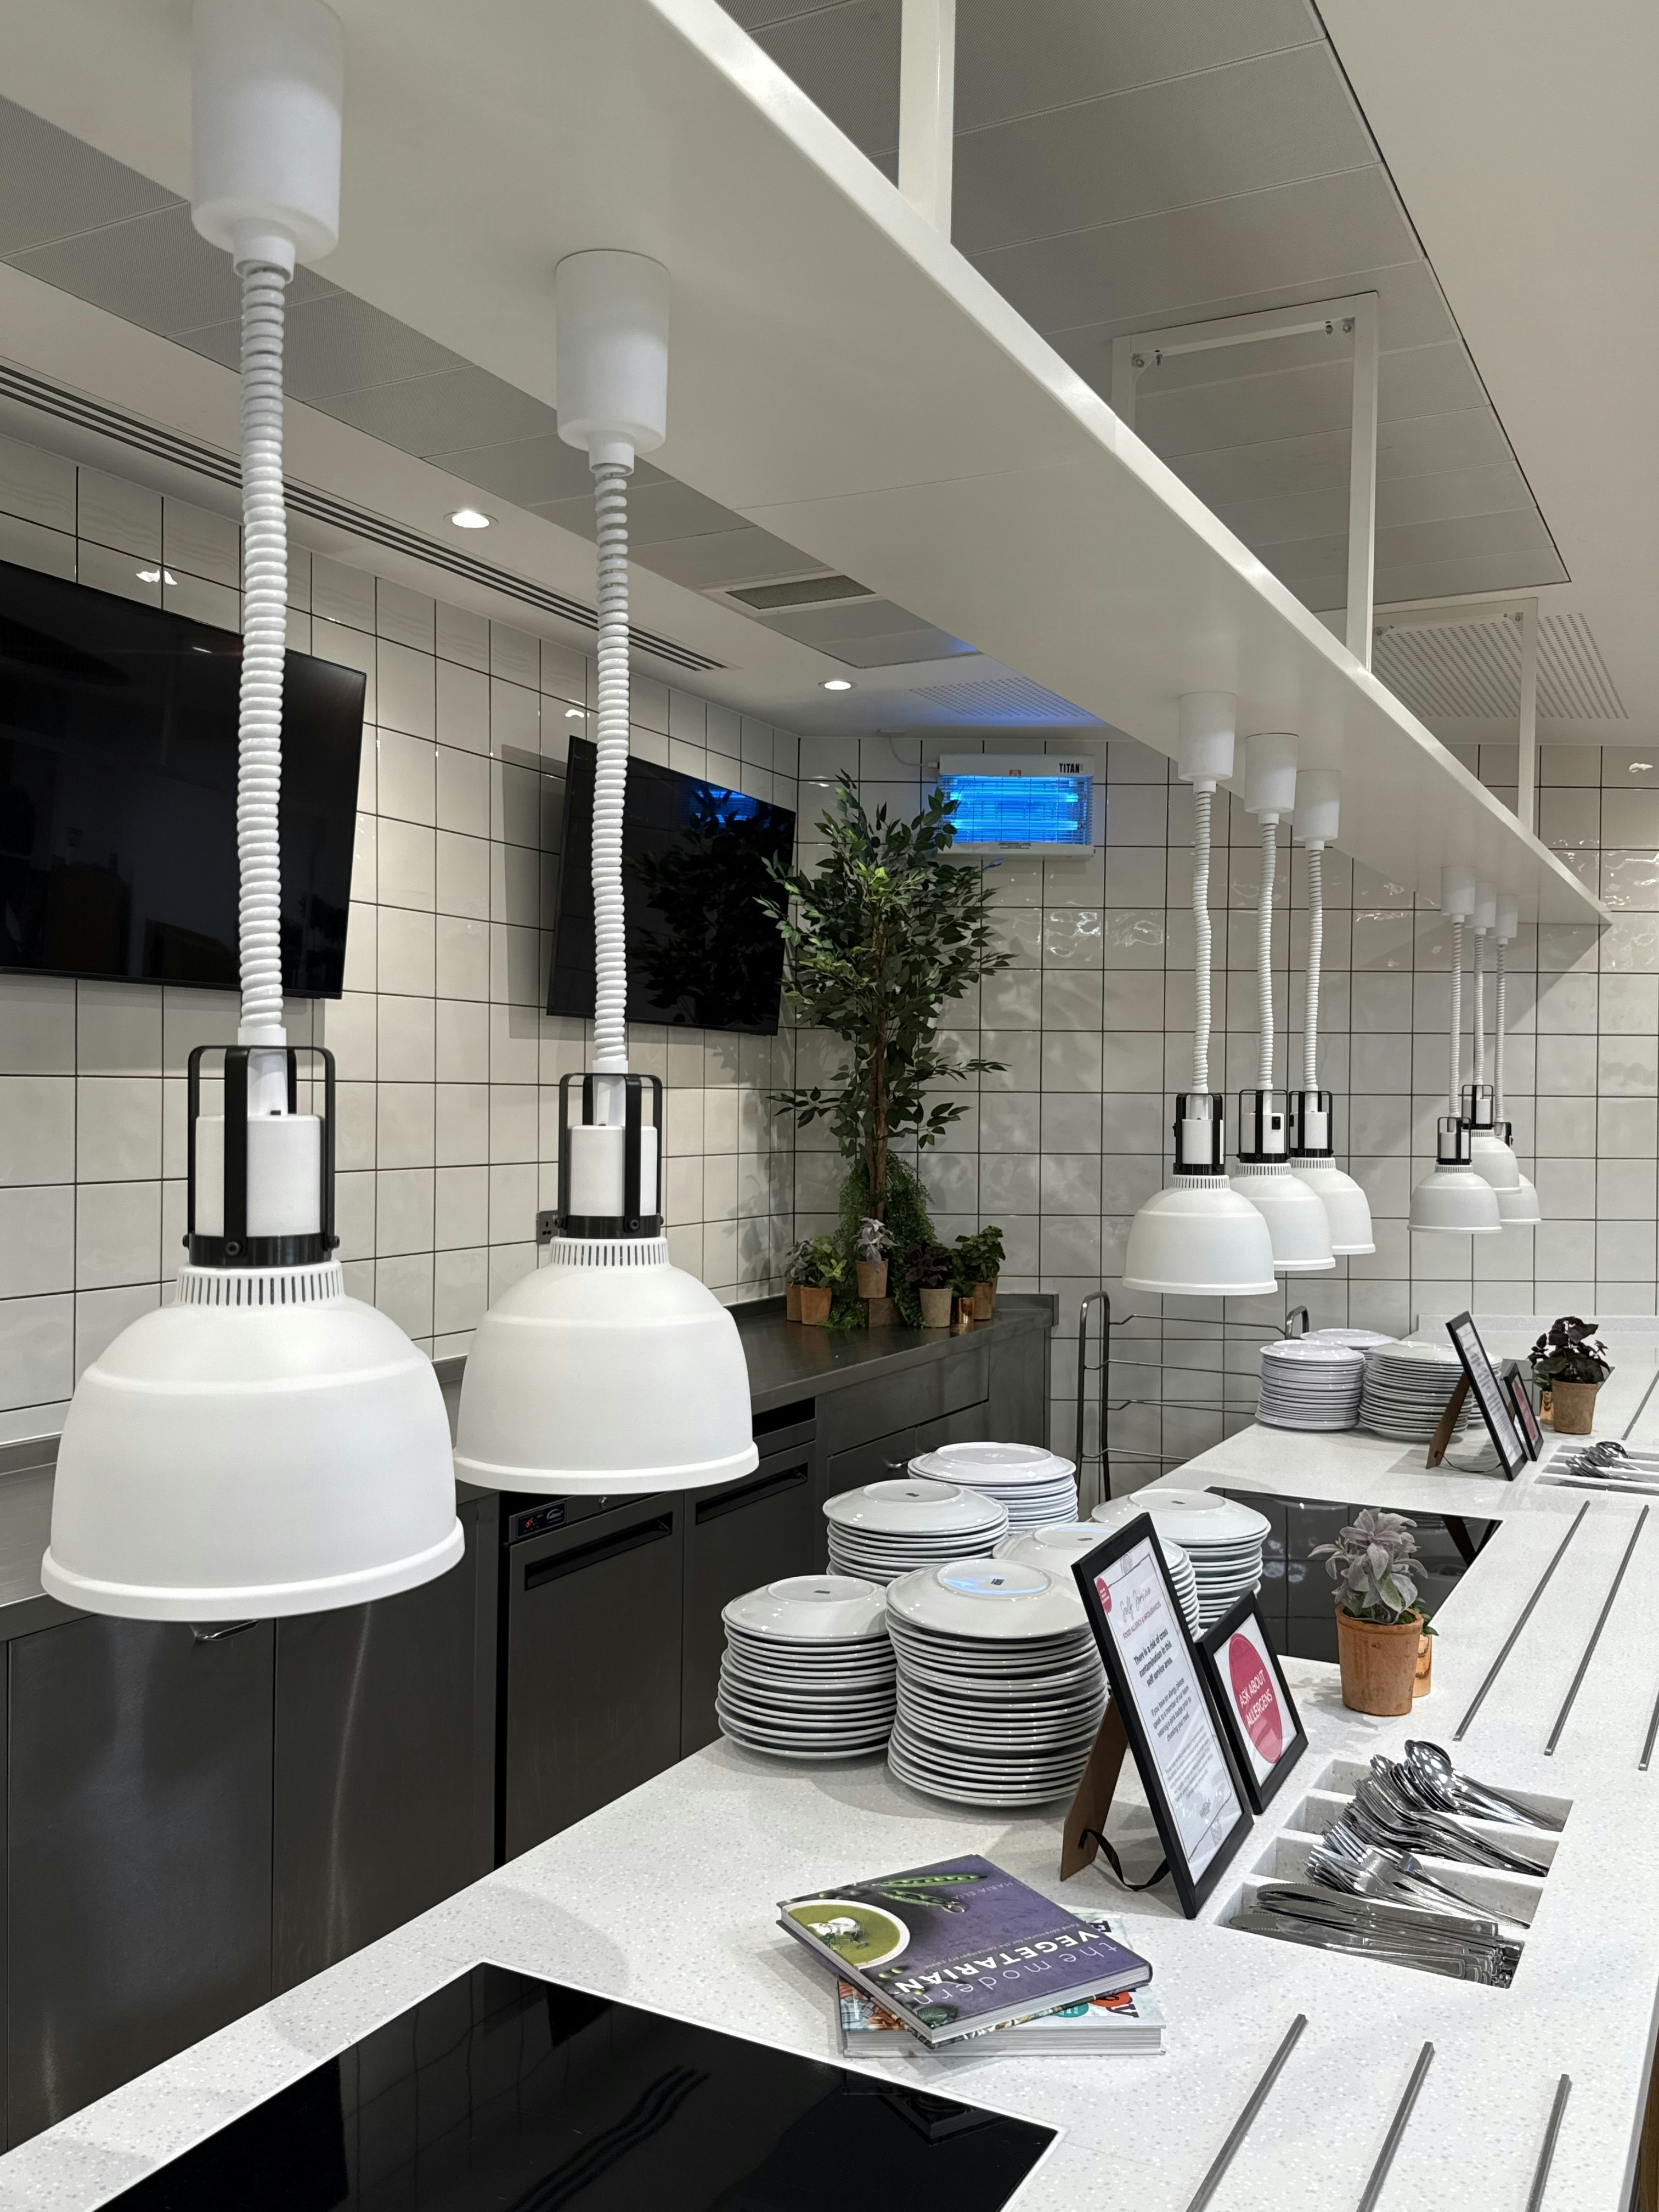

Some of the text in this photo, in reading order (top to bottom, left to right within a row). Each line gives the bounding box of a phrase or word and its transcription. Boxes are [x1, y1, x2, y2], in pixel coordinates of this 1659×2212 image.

[1059, 763, 1080, 774] TITAN
[1133, 1652, 1144, 1665] There
[1142, 1647, 1148, 1656] is
[1155, 1634, 1160, 1644] of
[1159, 1628, 1169, 1640] cross
[1139, 1651, 1163, 1677] contamination
[1160, 1646, 1166, 1655] in
[1153, 1664, 1165, 1680] service
[1239, 1669, 1266, 1708] ASK ABOUT
[1246, 1688, 1273, 1728] ALLERGENS
[952, 1882, 1013, 1899] MARIA ELIA
[896, 1931, 1100, 1993] VEGETARIAN
[913, 1942, 1118, 2005] the modern
